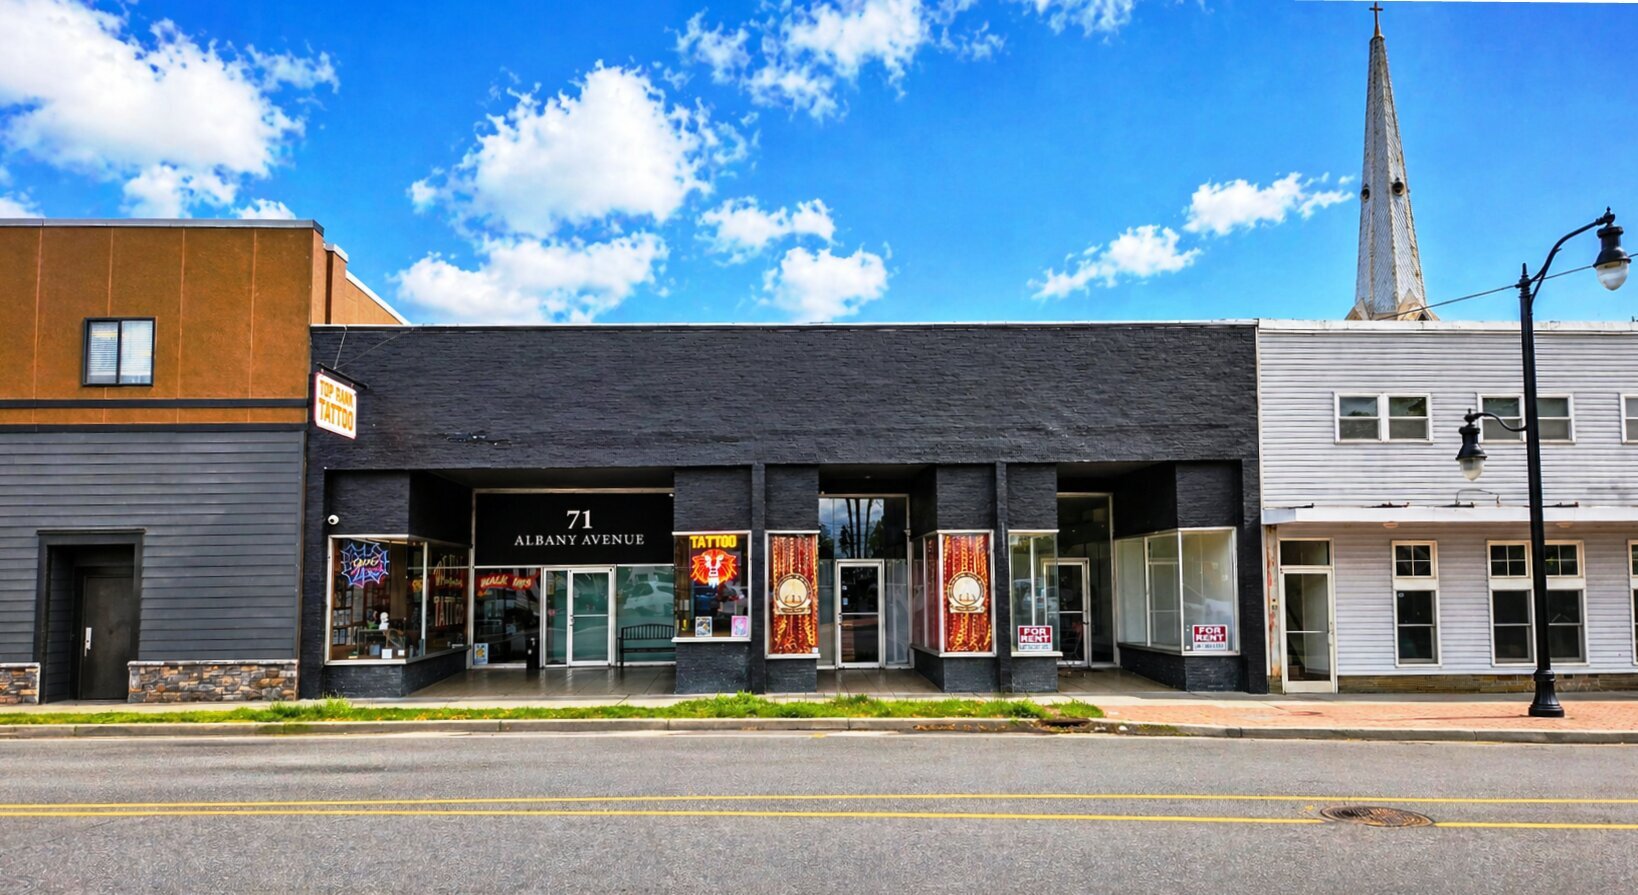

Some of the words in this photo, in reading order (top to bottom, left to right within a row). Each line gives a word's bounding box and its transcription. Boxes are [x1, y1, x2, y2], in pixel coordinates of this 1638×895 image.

[319, 379, 334, 399] TOP
[318, 397, 353, 431] TATTOO
[566, 510, 593, 530] 71
[514, 534, 578, 546] ALBANY
[581, 533, 645, 546] AVENUE
[689, 534, 737, 549] TATTOO
[480, 574, 509, 588] WALK
[1020, 635, 1050, 643] RENT
[1023, 628, 1046, 636] FOR
[1195, 634, 1224, 642] RENT
